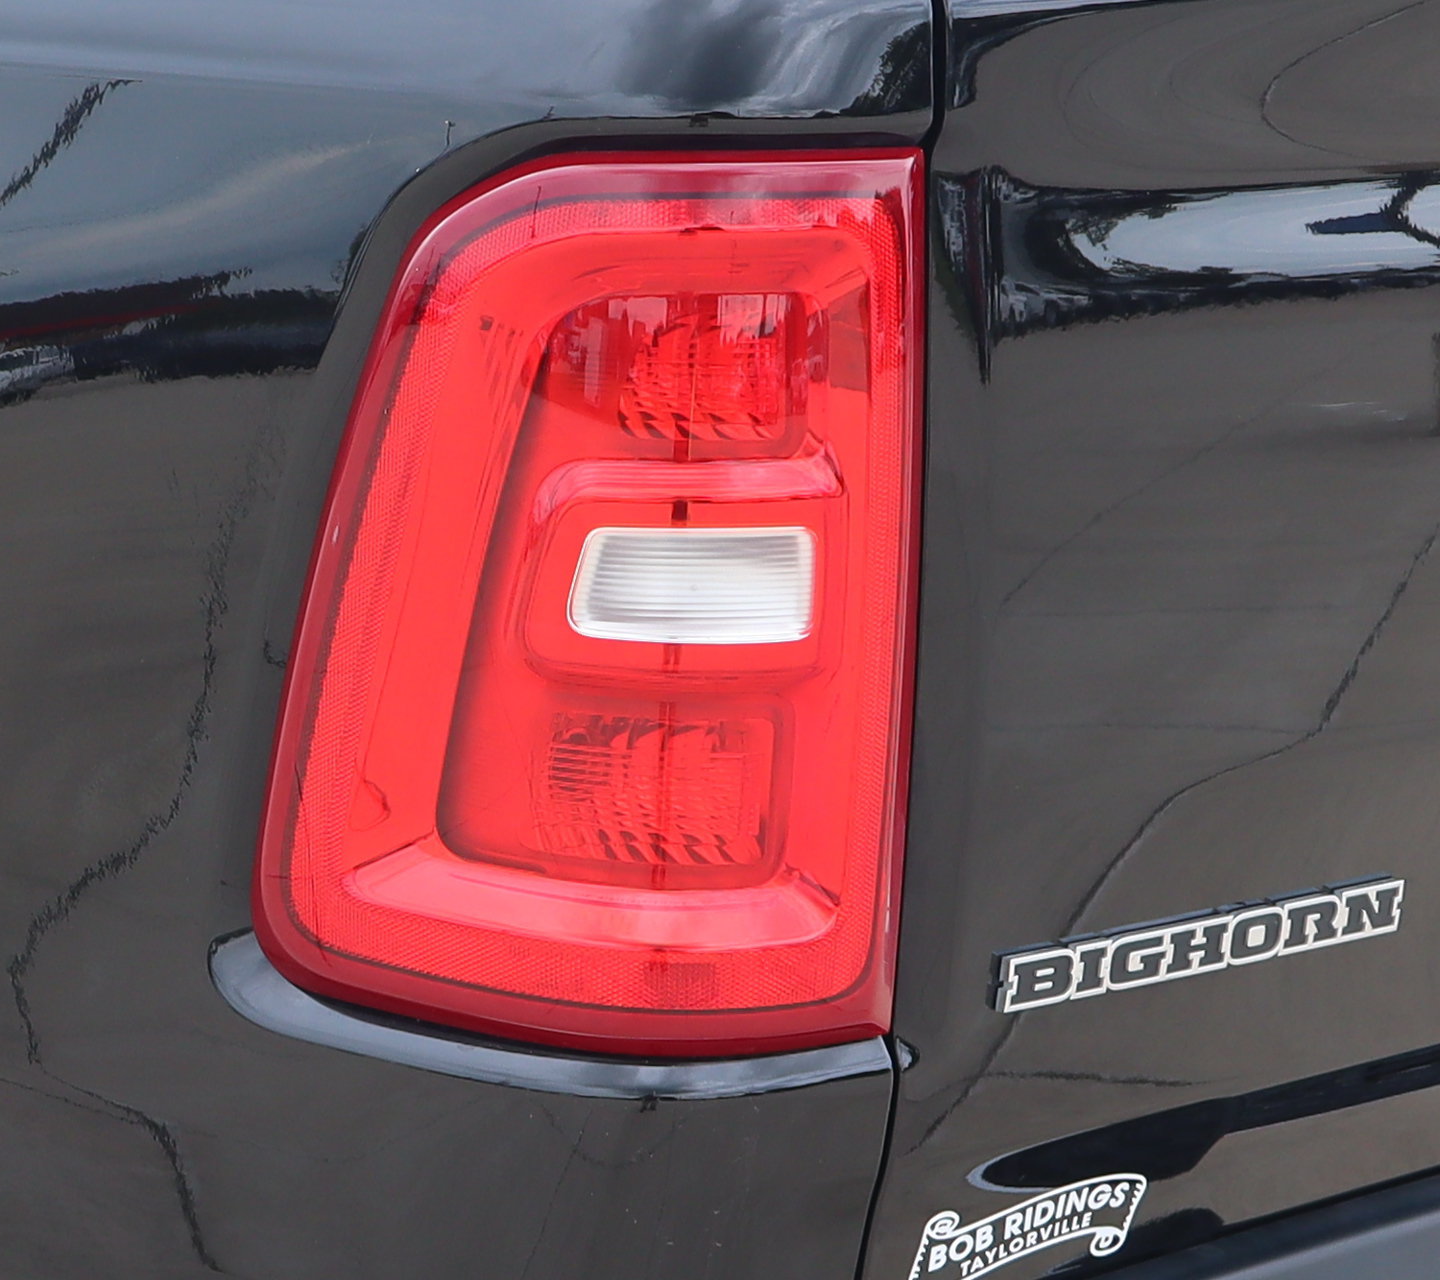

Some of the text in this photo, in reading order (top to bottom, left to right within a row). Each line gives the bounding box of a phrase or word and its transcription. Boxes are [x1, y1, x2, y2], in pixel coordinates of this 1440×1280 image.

[992, 874, 1406, 1014] BIGHORN
[928, 1182, 1130, 1272] BOB RIDINGS
[960, 1212, 1093, 1277] TAYLORVILLE
